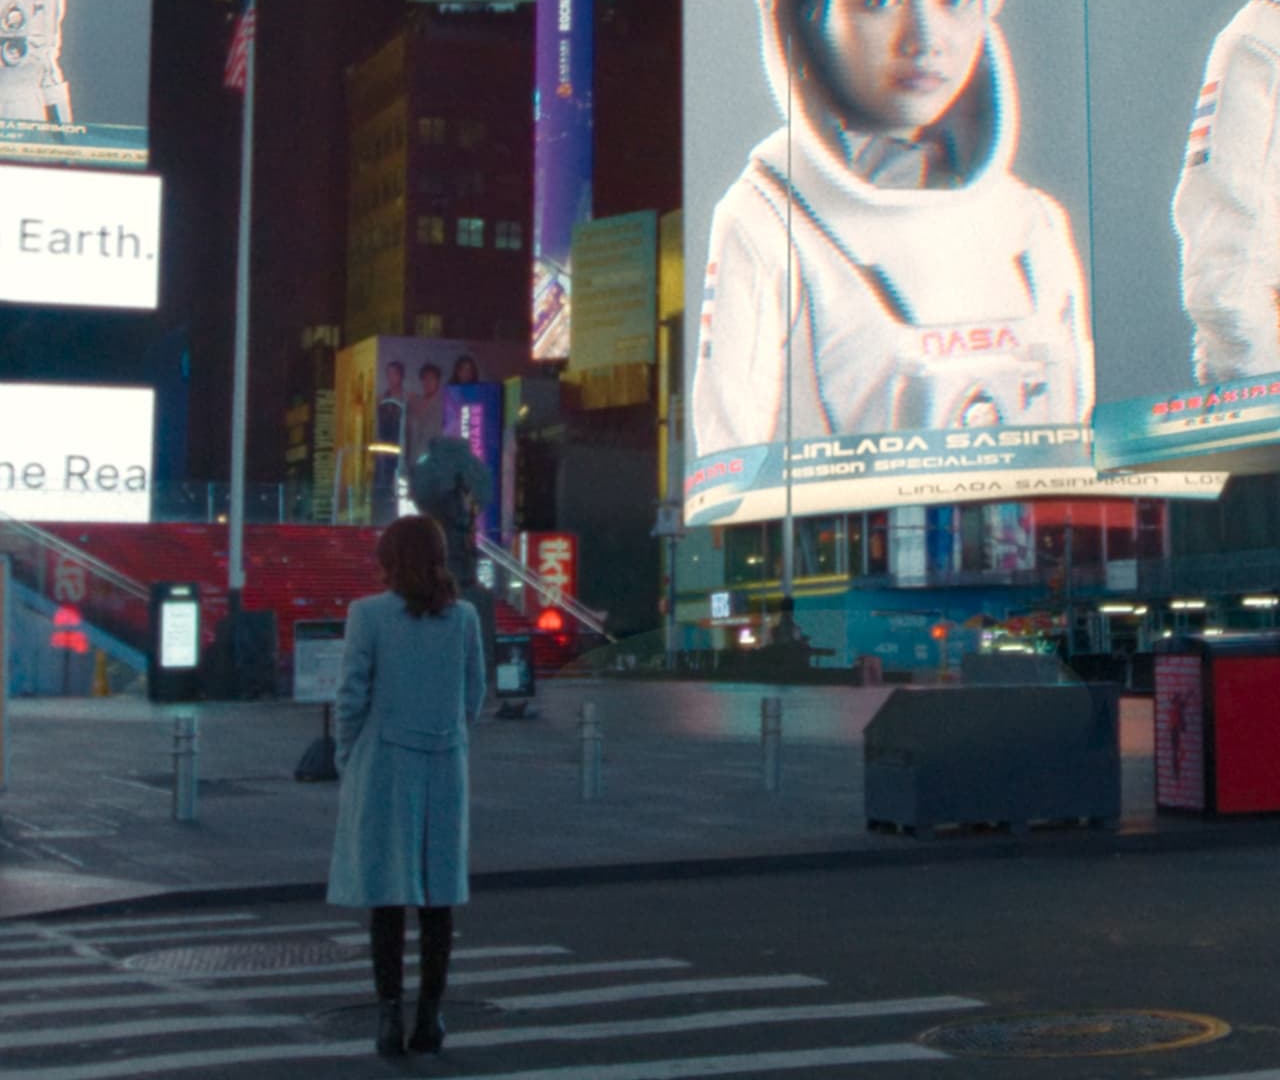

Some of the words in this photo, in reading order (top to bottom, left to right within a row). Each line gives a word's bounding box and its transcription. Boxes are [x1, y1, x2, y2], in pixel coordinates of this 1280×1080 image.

[20, 219, 154, 261] Earth.
[922, 328, 1020, 357] NASA
[783, 436, 928, 461] LINLADA
[945, 429, 1093, 448] SASINPI
[65, 455, 148, 492] Rea
[874, 452, 1016, 471] SPECIALIST
[898, 480, 1003, 496] LINLADA
